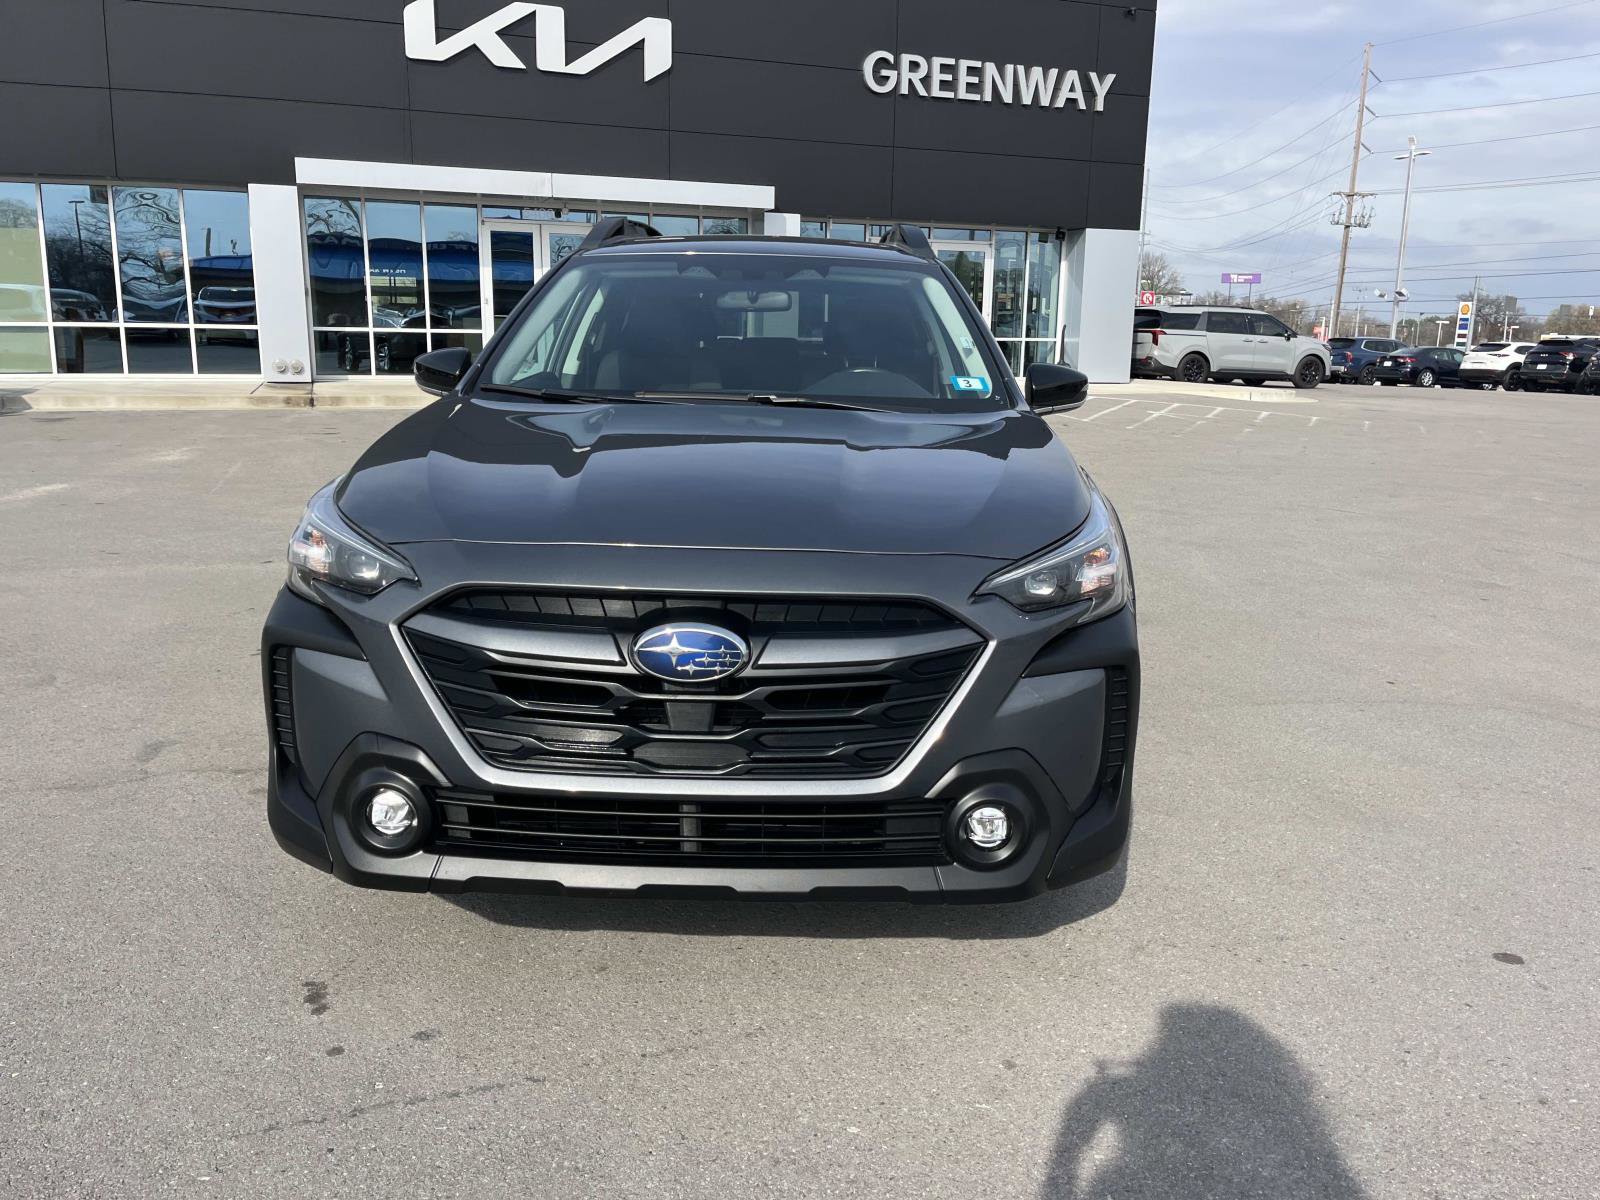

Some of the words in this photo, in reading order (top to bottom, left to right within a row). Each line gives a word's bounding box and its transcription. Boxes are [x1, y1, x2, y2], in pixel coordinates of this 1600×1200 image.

[403, 0, 672, 82] KIA
[863, 50, 1117, 112] GREENWAY
[962, 379, 972, 388] 3
